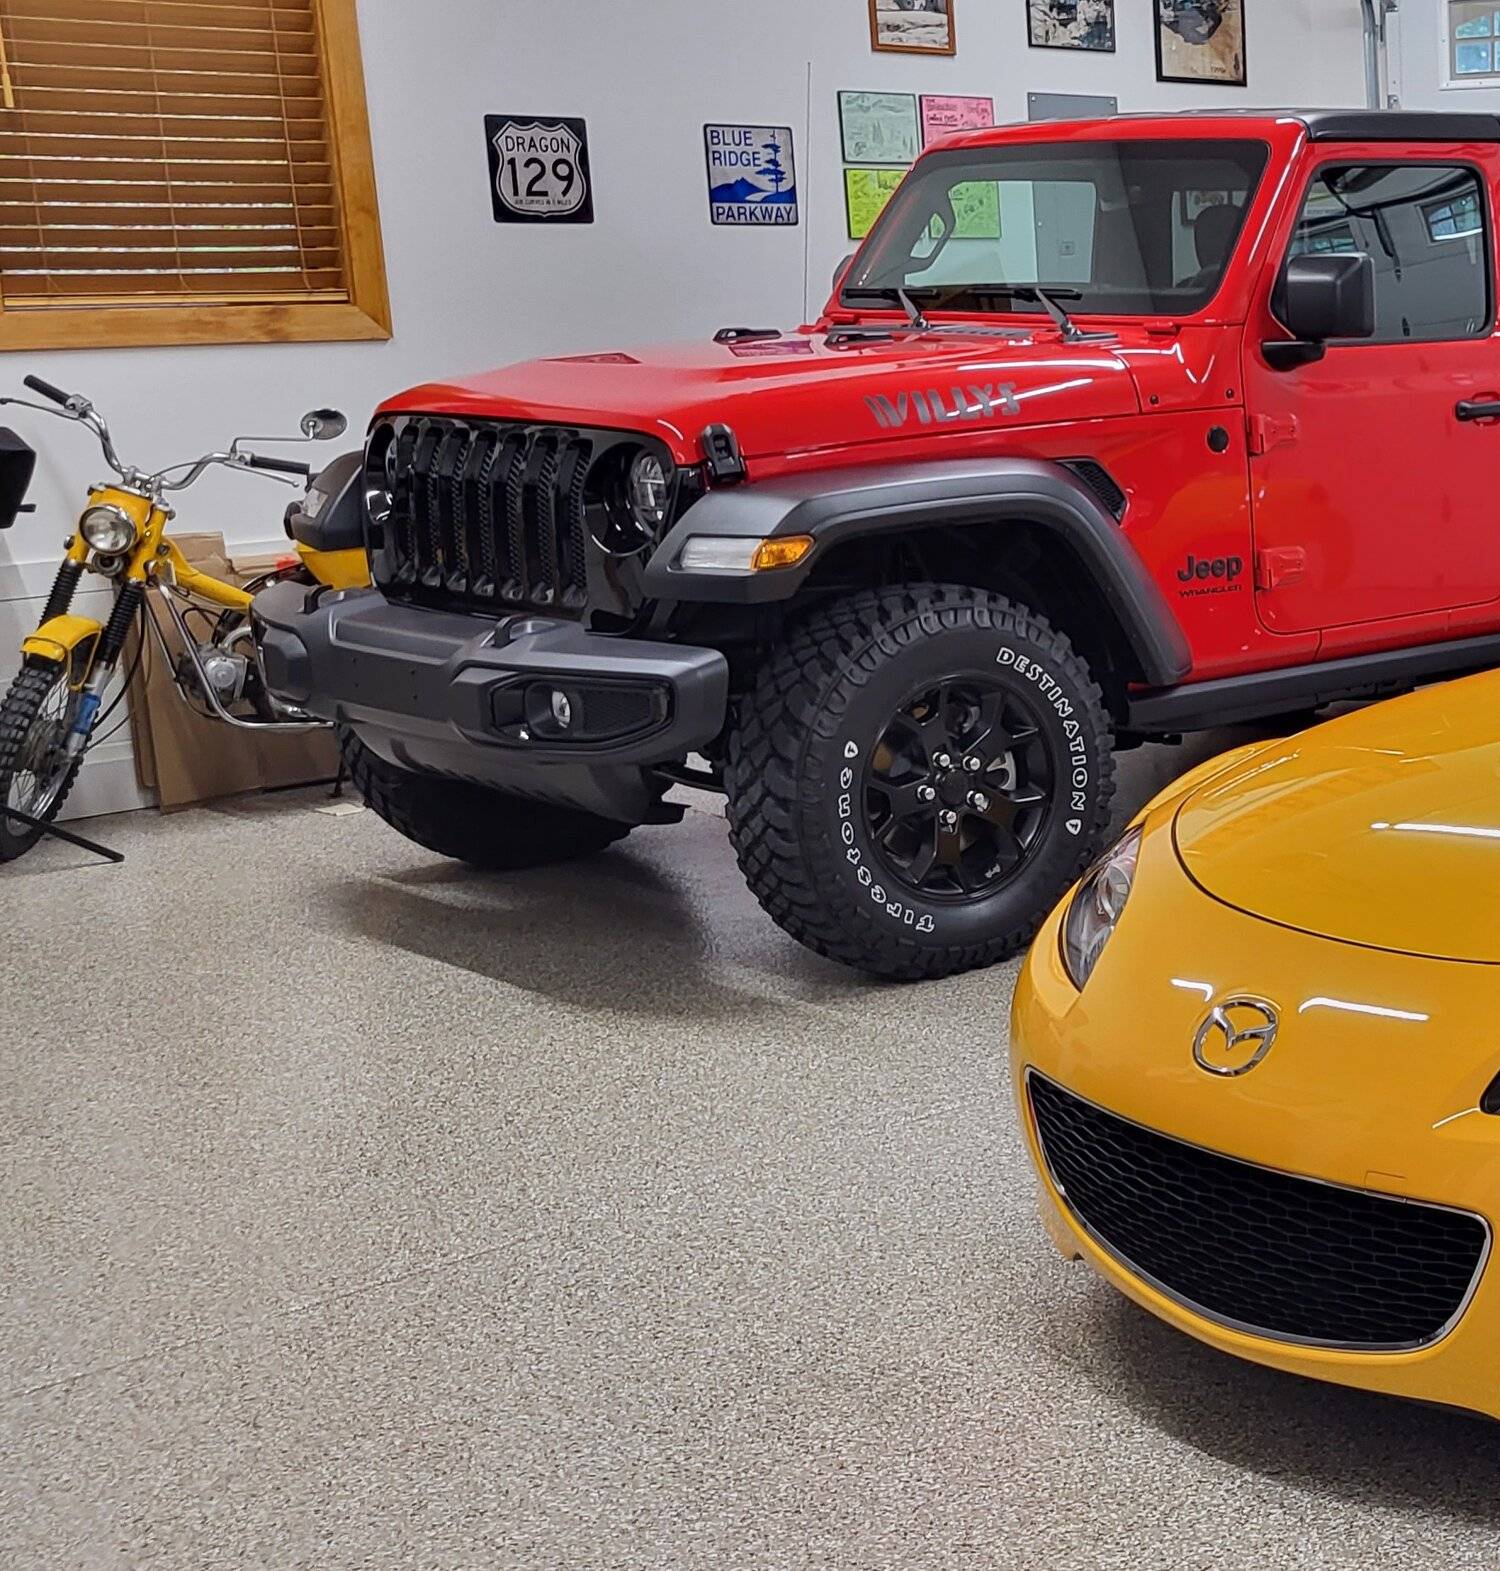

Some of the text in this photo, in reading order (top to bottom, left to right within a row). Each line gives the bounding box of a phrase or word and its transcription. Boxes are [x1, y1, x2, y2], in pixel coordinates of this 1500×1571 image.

[504, 135, 571, 154] DRAGON
[710, 129, 754, 146] BLUE
[712, 150, 762, 167] RIDGE
[507, 157, 575, 197] 129
[715, 205, 793, 222] PARKWAY
[863, 381, 1021, 428] WILLYS
[1176, 555, 1243, 581] Jeep
[996, 647, 1088, 812] DESTINATION
